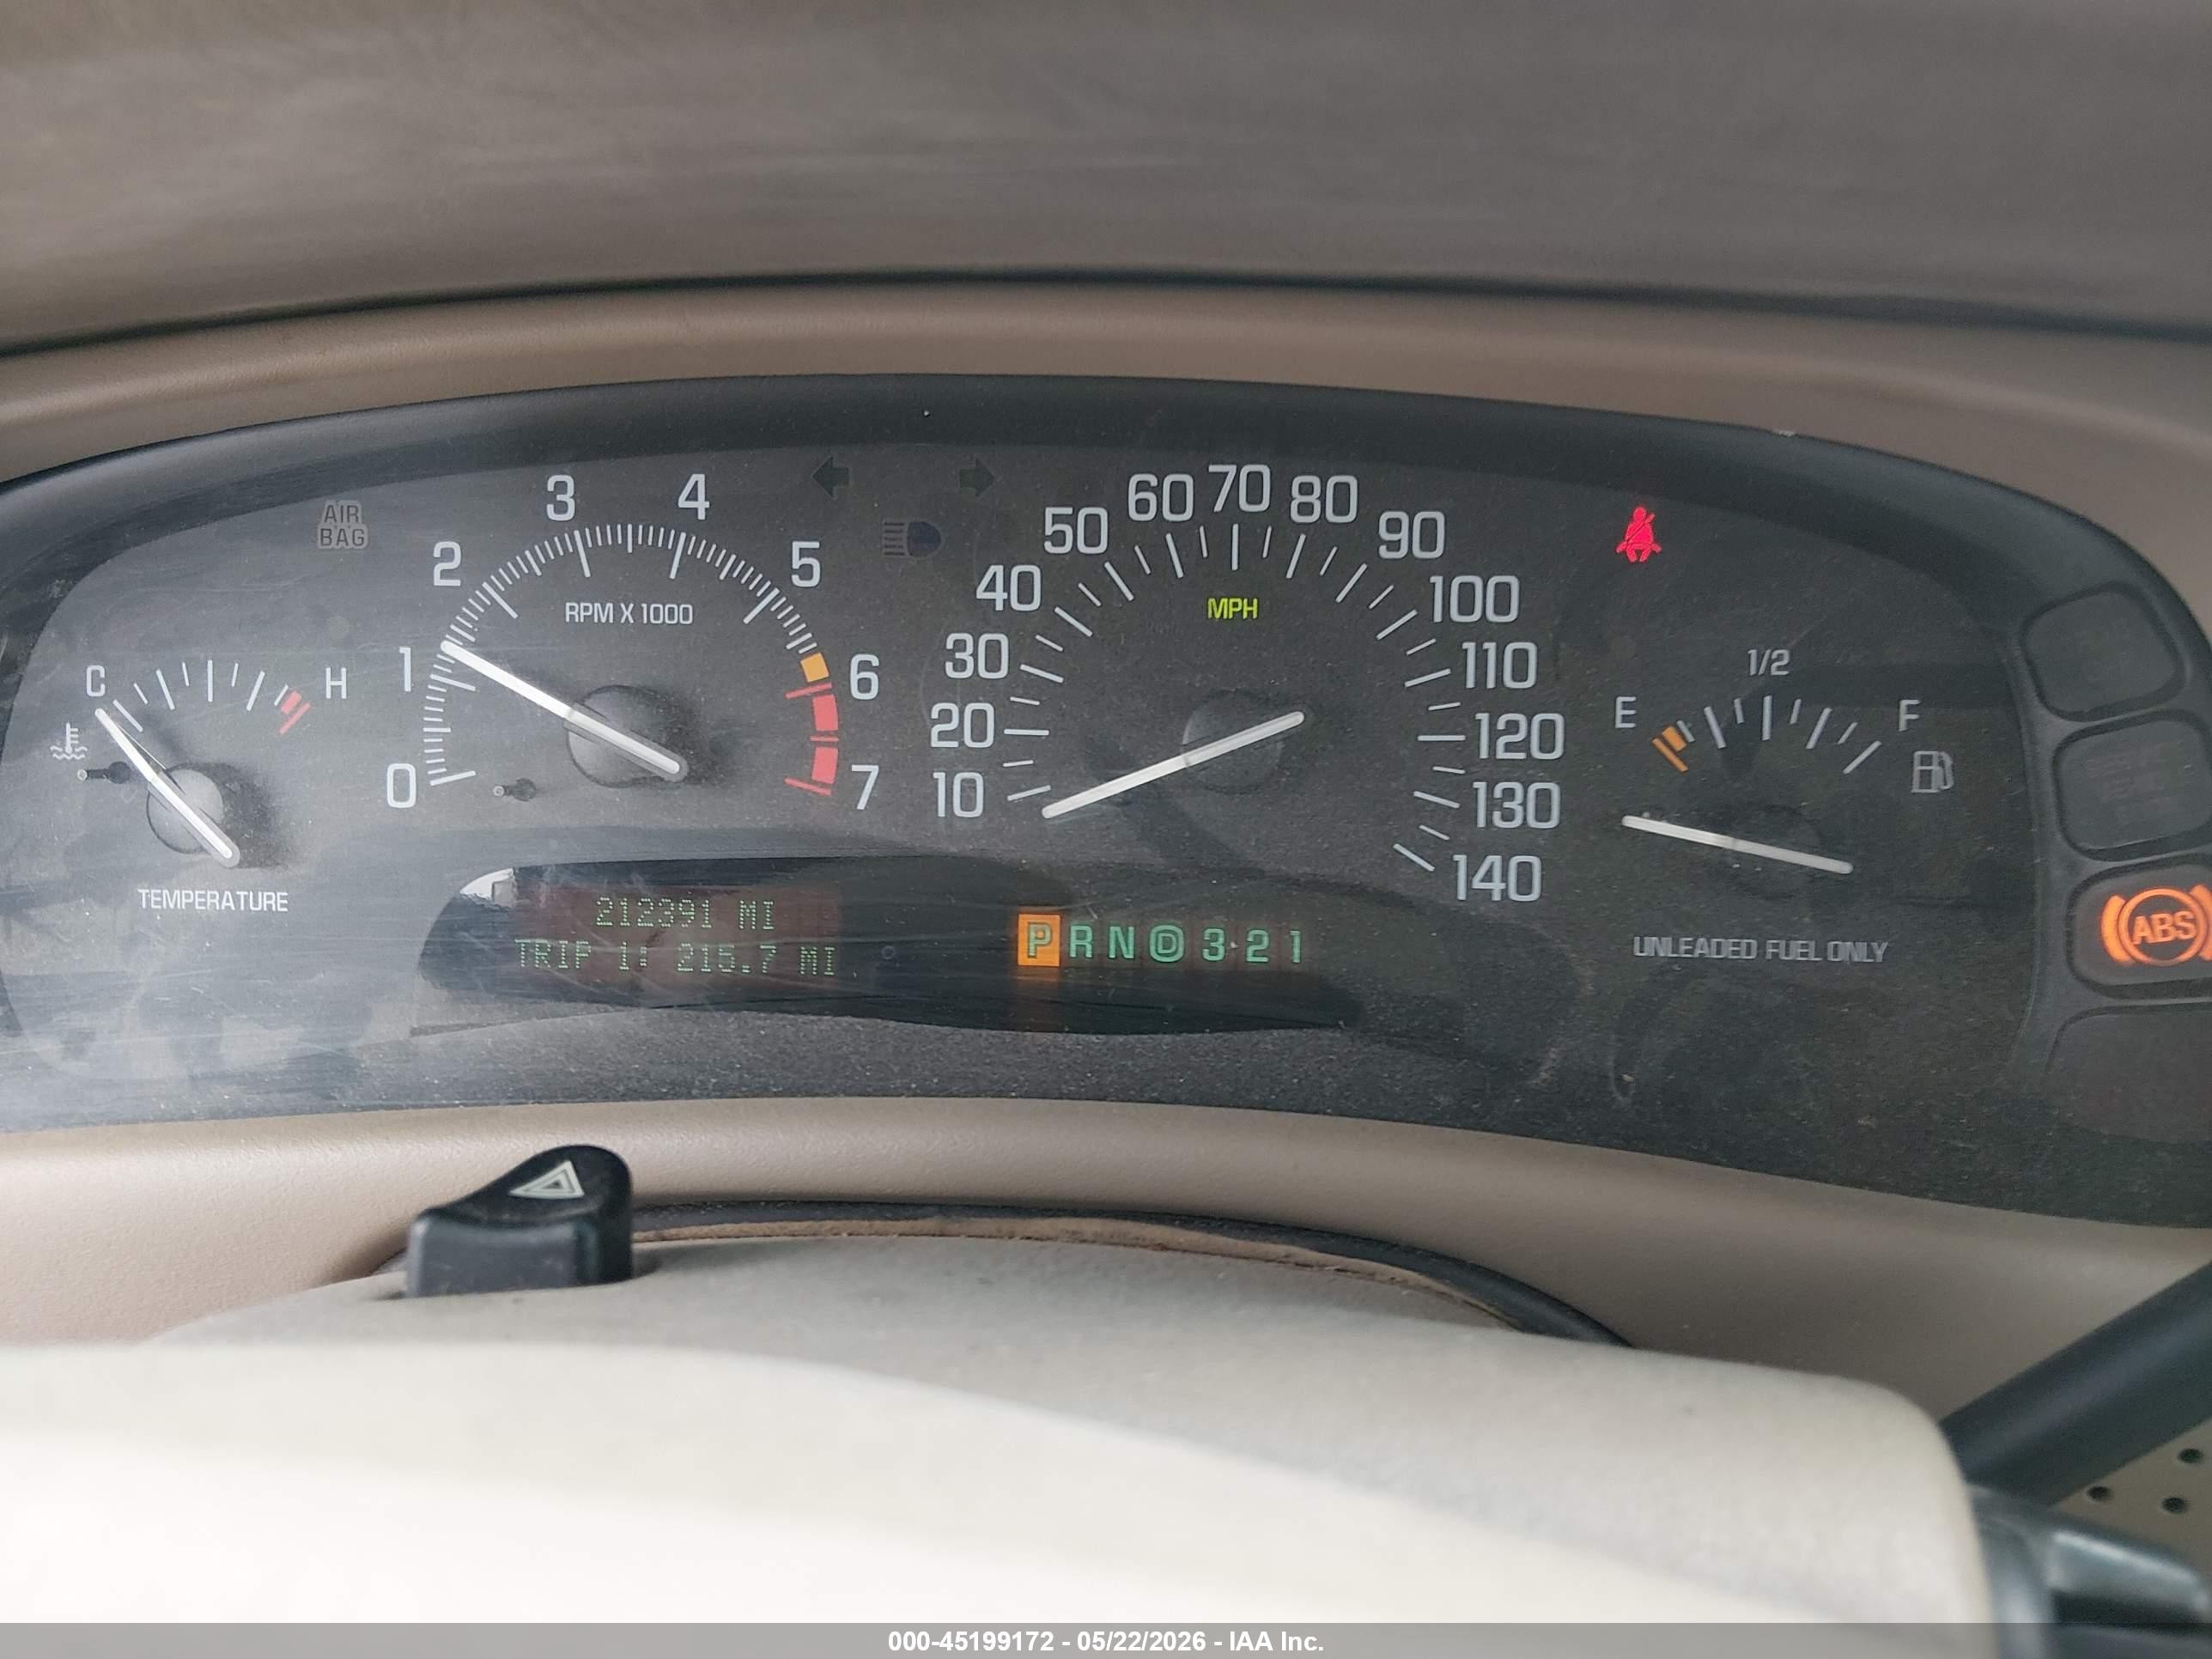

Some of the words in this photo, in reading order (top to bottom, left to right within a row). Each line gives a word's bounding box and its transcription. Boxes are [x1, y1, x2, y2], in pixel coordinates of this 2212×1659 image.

[547, 475, 575, 521] 3
[678, 474, 710, 520] 4
[1127, 474, 1194, 522] 60
[1208, 465, 1271, 513] 70
[1291, 475, 1358, 524] 80
[324, 504, 360, 524] AIR
[1043, 507, 1108, 555] 50
[1378, 511, 1445, 560] 90
[319, 528, 366, 548] BAG
[434, 541, 462, 586] 2
[791, 541, 820, 587] 5
[975, 564, 1042, 611] 40
[1207, 597, 1258, 620] MPH
[1430, 575, 1520, 623] 100
[565, 603, 613, 624] RPM
[620, 604, 635, 624] X
[641, 604, 694, 625] 1000
[399, 647, 412, 691] 1
[849, 653, 878, 700] 6
[945, 633, 1009, 679] 30
[1462, 641, 1538, 689] 110
[1747, 649, 1790, 676] 1/2
[86, 665, 106, 696] C
[325, 667, 347, 698] H
[931, 703, 994, 749] 20
[1615, 696, 1637, 728] E
[1899, 700, 1920, 732] F
[1475, 713, 1565, 760] 120
[387, 763, 416, 807] 0
[851, 764, 878, 810] 7
[933, 773, 985, 818] 10
[1473, 781, 1560, 829] 130
[138, 889, 289, 912] TEMPERATURE
[1454, 854, 1542, 902] 140
[595, 896, 714, 928] 212391
[739, 900, 775, 930] MI
[2131, 910, 2198, 945] ABS
[514, 939, 592, 969] TRIP
[619, 941, 647, 971] 1:
[678, 943, 777, 974] 215.7
[799, 946, 836, 975] MI
[1027, 924, 1052, 958] P
[1069, 925, 1092, 958] R
[1109, 926, 1134, 959] N
[1203, 928, 1225, 960] 3
[1246, 929, 1269, 963] 2
[1291, 931, 1301, 963] 1
[1633, 936, 1758, 960] UNLEADED
[1765, 939, 1823, 962] FUEL
[1826, 941, 1889, 963] ONLY
